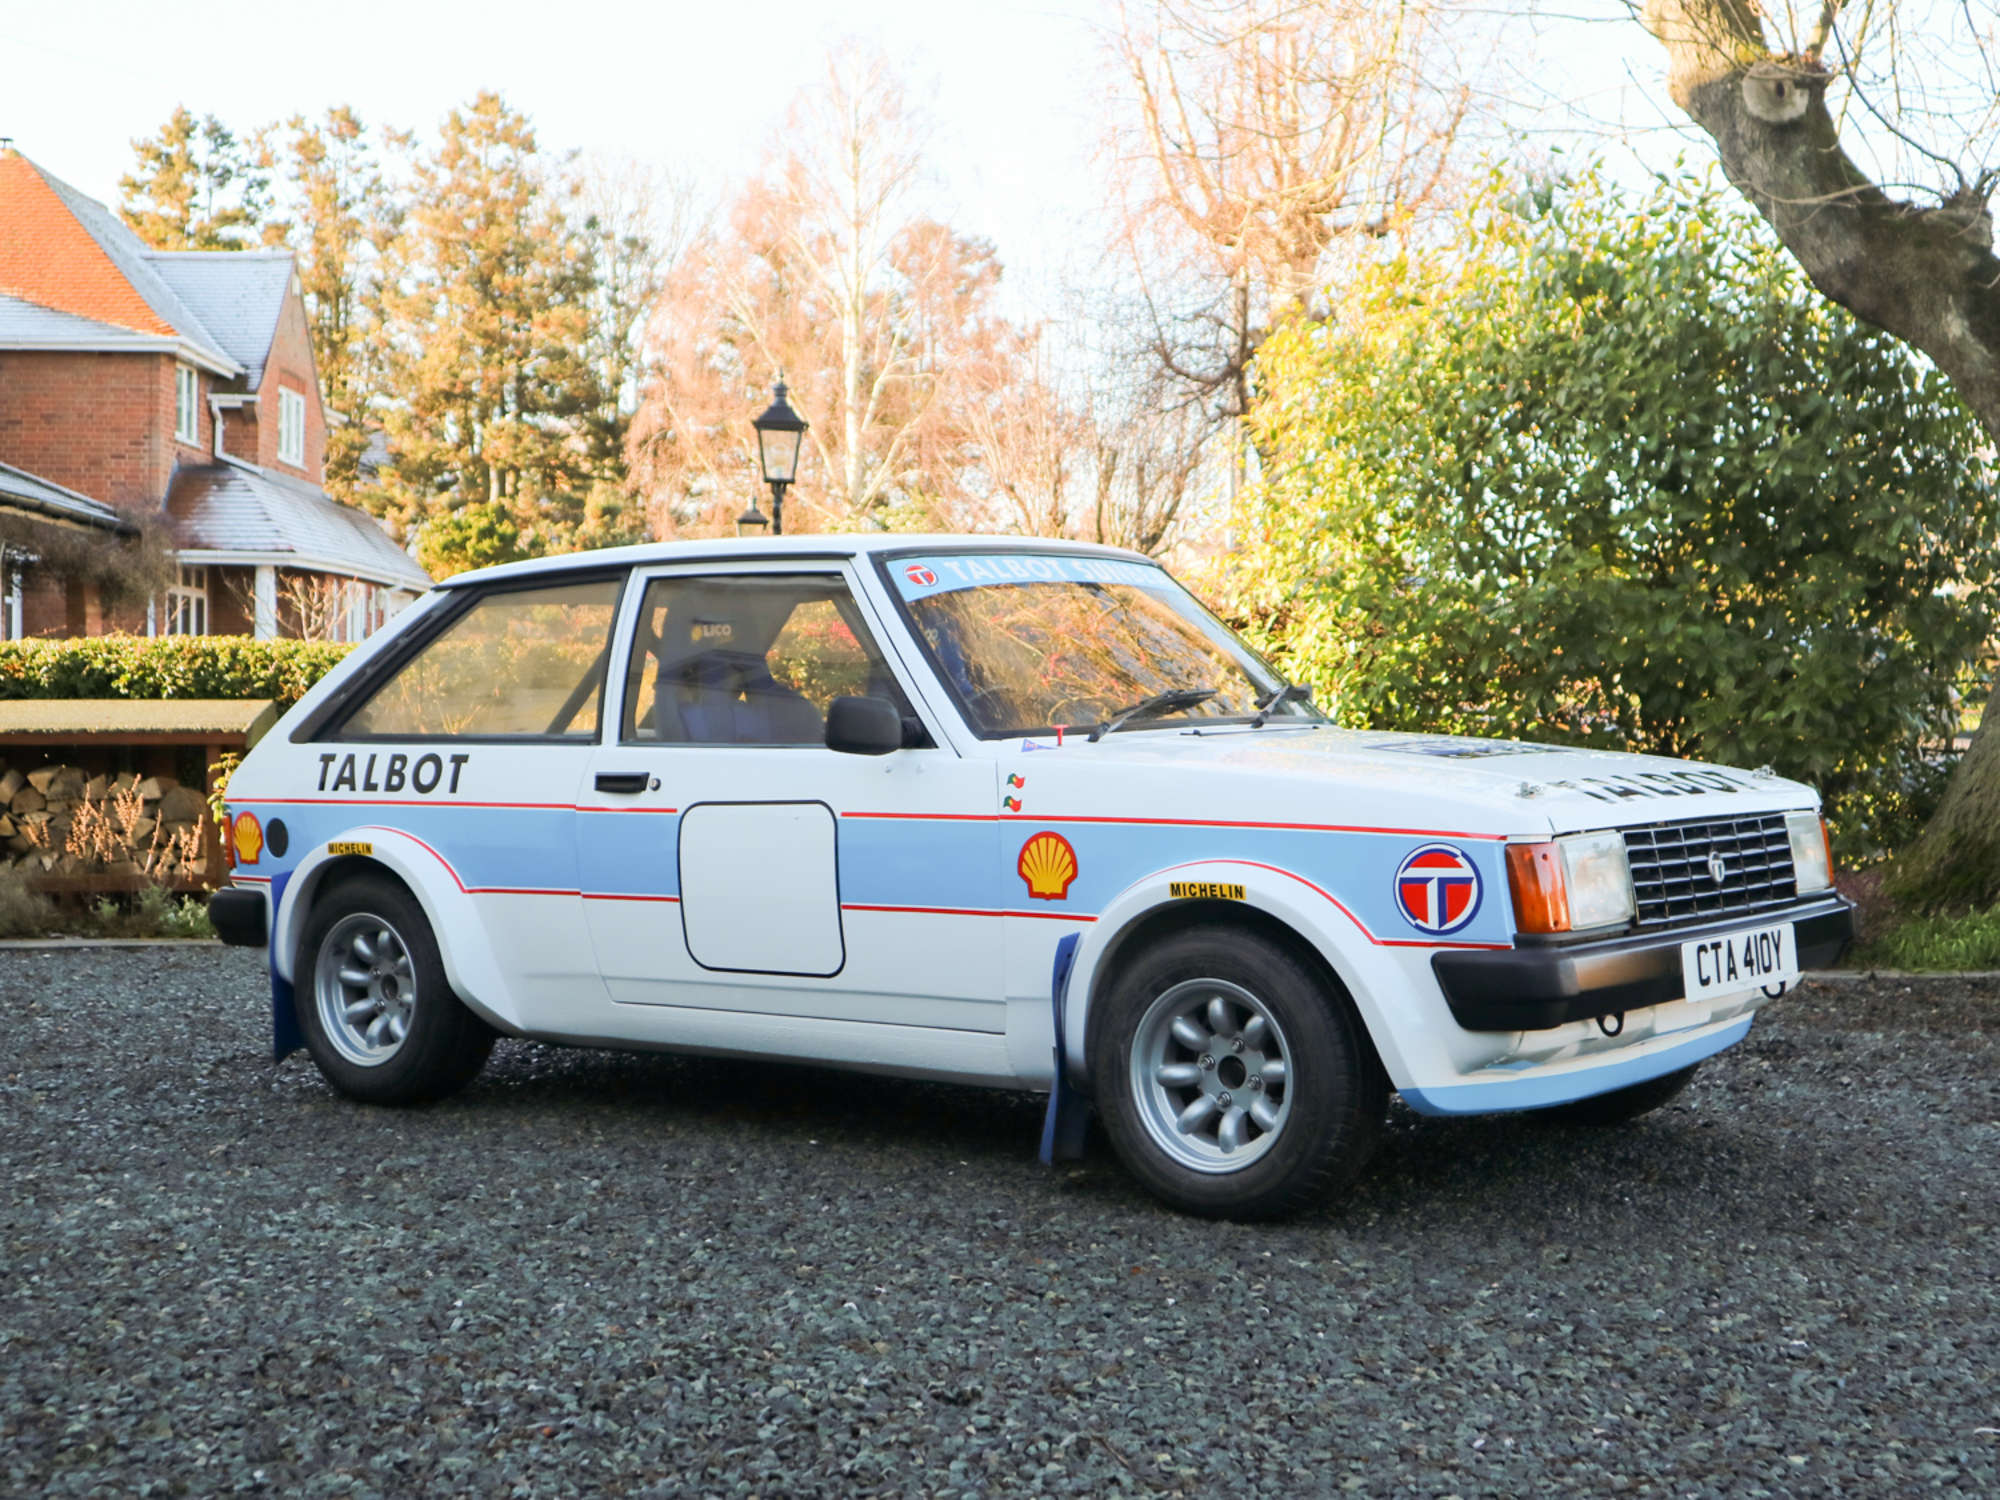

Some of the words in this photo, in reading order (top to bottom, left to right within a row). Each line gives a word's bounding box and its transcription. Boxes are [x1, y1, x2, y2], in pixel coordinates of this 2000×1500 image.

[944, 558, 1069, 581] TALBOT
[318, 753, 469, 794] TALBOT
[1546, 771, 1758, 804] TALBOT
[328, 843, 372, 855] MICHELIN
[1170, 883, 1244, 898] MICHELIN
[1697, 939, 1738, 987] CTA
[1744, 929, 1781, 977] 410Y
